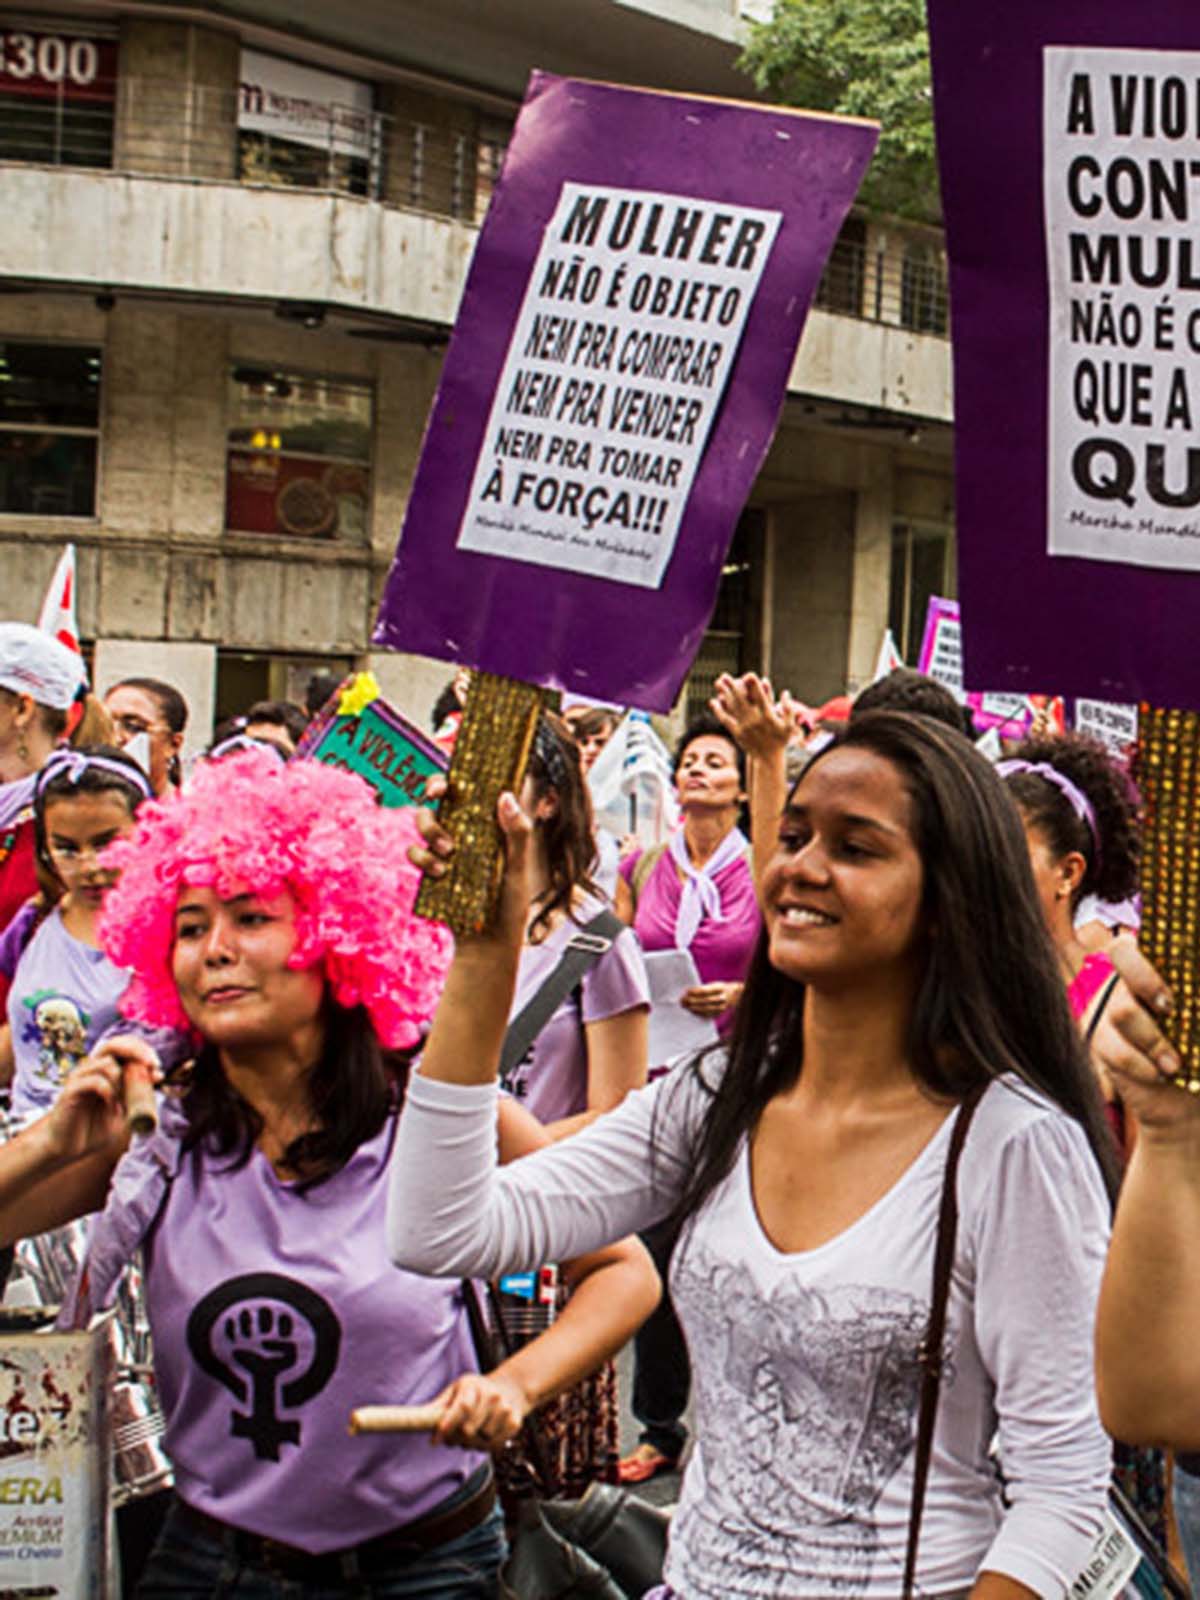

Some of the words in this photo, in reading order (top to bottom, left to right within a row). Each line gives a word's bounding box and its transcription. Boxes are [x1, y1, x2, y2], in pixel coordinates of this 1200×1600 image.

[0, 32, 97, 85] 300
[1066, 73, 1095, 136] A
[560, 194, 767, 272] MULHER
[540, 254, 604, 305] NÃO
[605, 262, 628, 309] É
[629, 271, 742, 326] OBJETO
[1070, 291, 1142, 348] NÃO
[1154, 294, 1176, 351] É
[523, 312, 578, 362] NEM
[572, 321, 620, 372] PRA
[616, 329, 724, 388] COMPRAR
[505, 368, 562, 418] NEM
[556, 377, 609, 428] PRA
[608, 386, 704, 445] VENDER
[1073, 358, 1154, 428] QUE
[1164, 366, 1192, 431] A
[493, 426, 543, 460] NEM
[545, 435, 590, 472] PRA
[598, 446, 683, 488] TOMAR
[480, 459, 503, 503] À
[512, 472, 669, 535] FORÇA!!!
[1070, 509, 1133, 532] Marcha
[337, 717, 361, 747] A
